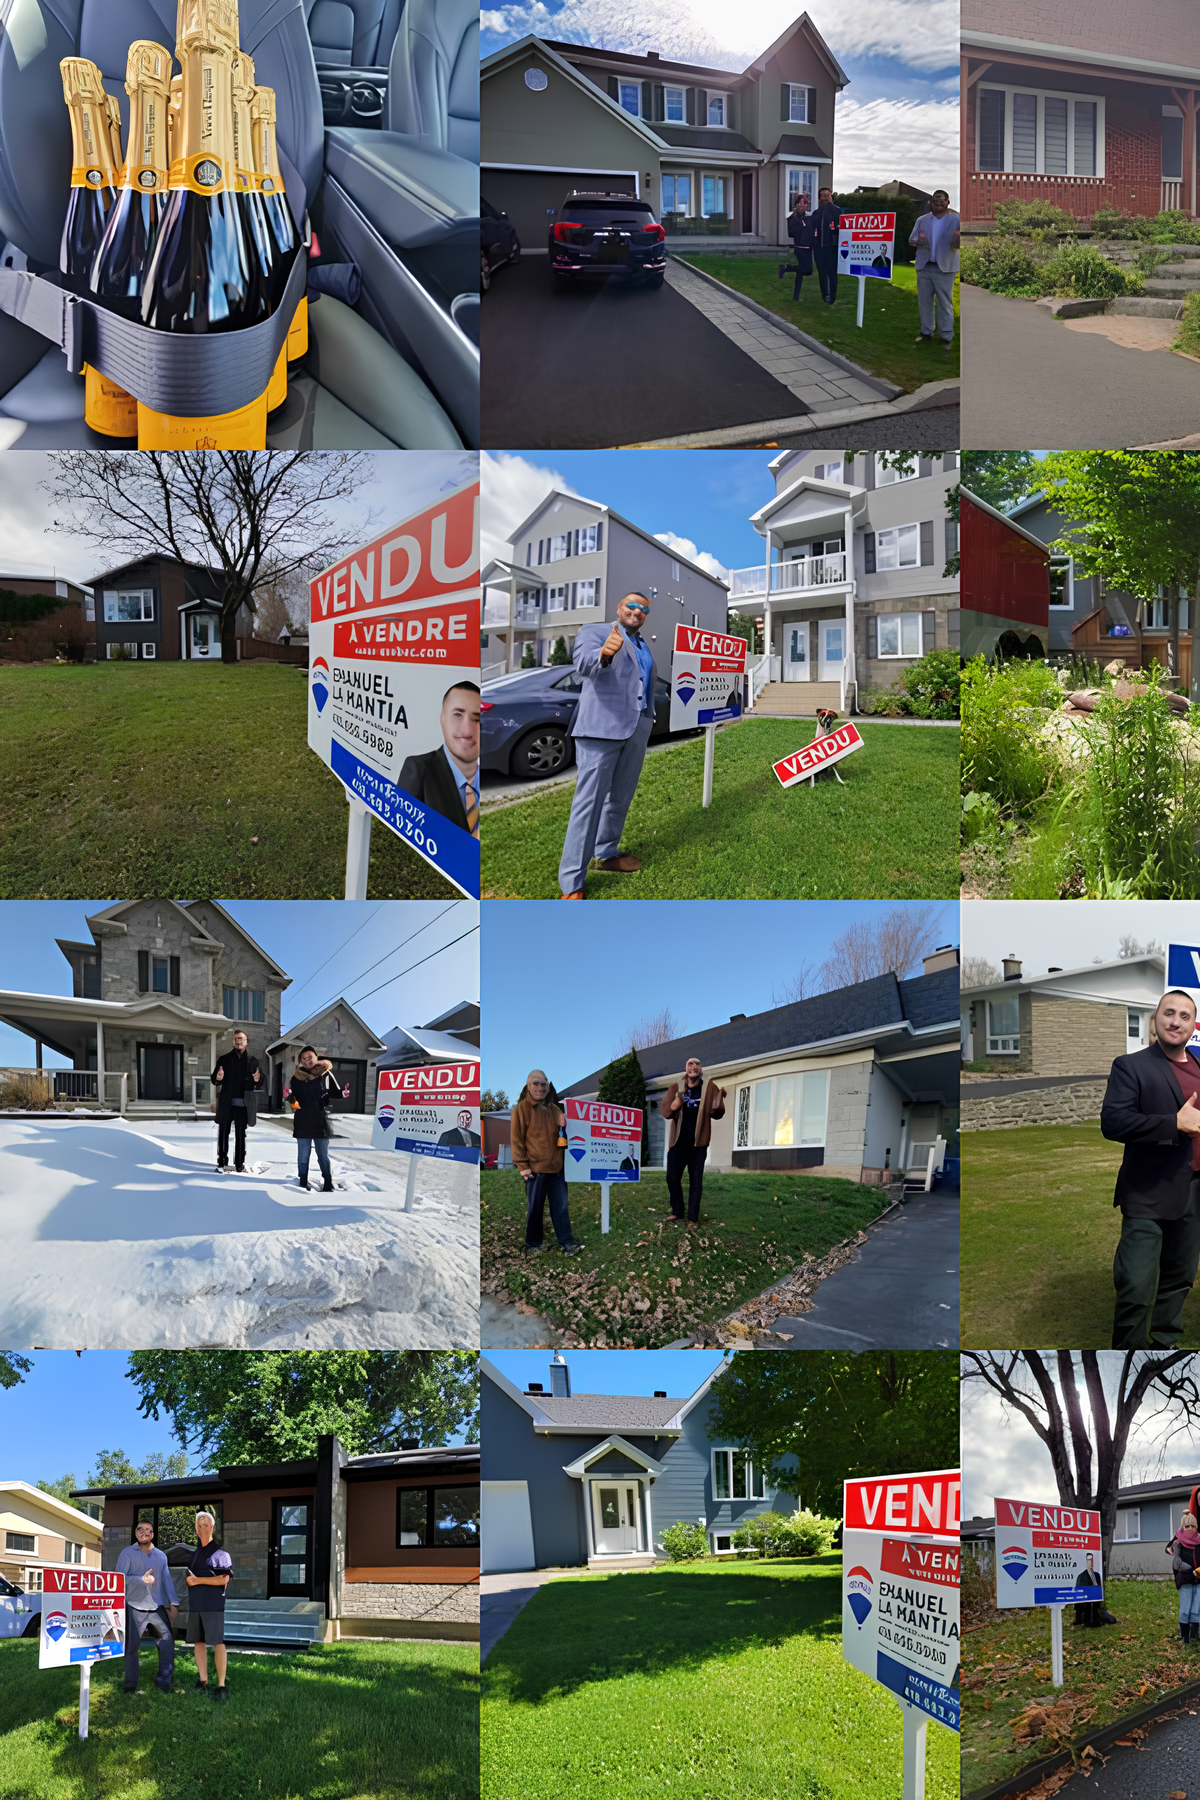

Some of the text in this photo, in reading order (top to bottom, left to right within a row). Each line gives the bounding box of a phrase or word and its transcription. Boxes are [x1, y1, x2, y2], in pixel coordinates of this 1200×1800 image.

[317, 495, 480, 617] VENDU
[363, 614, 467, 642] VENDRE
[687, 630, 742, 657] VENDU
[783, 729, 850, 774] VENDU
[389, 1065, 475, 1089] VENDU
[575, 1101, 635, 1126] VENDU
[1008, 1502, 1090, 1531] VENDU
[54, 1571, 118, 1592] VENDU
[897, 1604, 960, 1641] MANTIA
